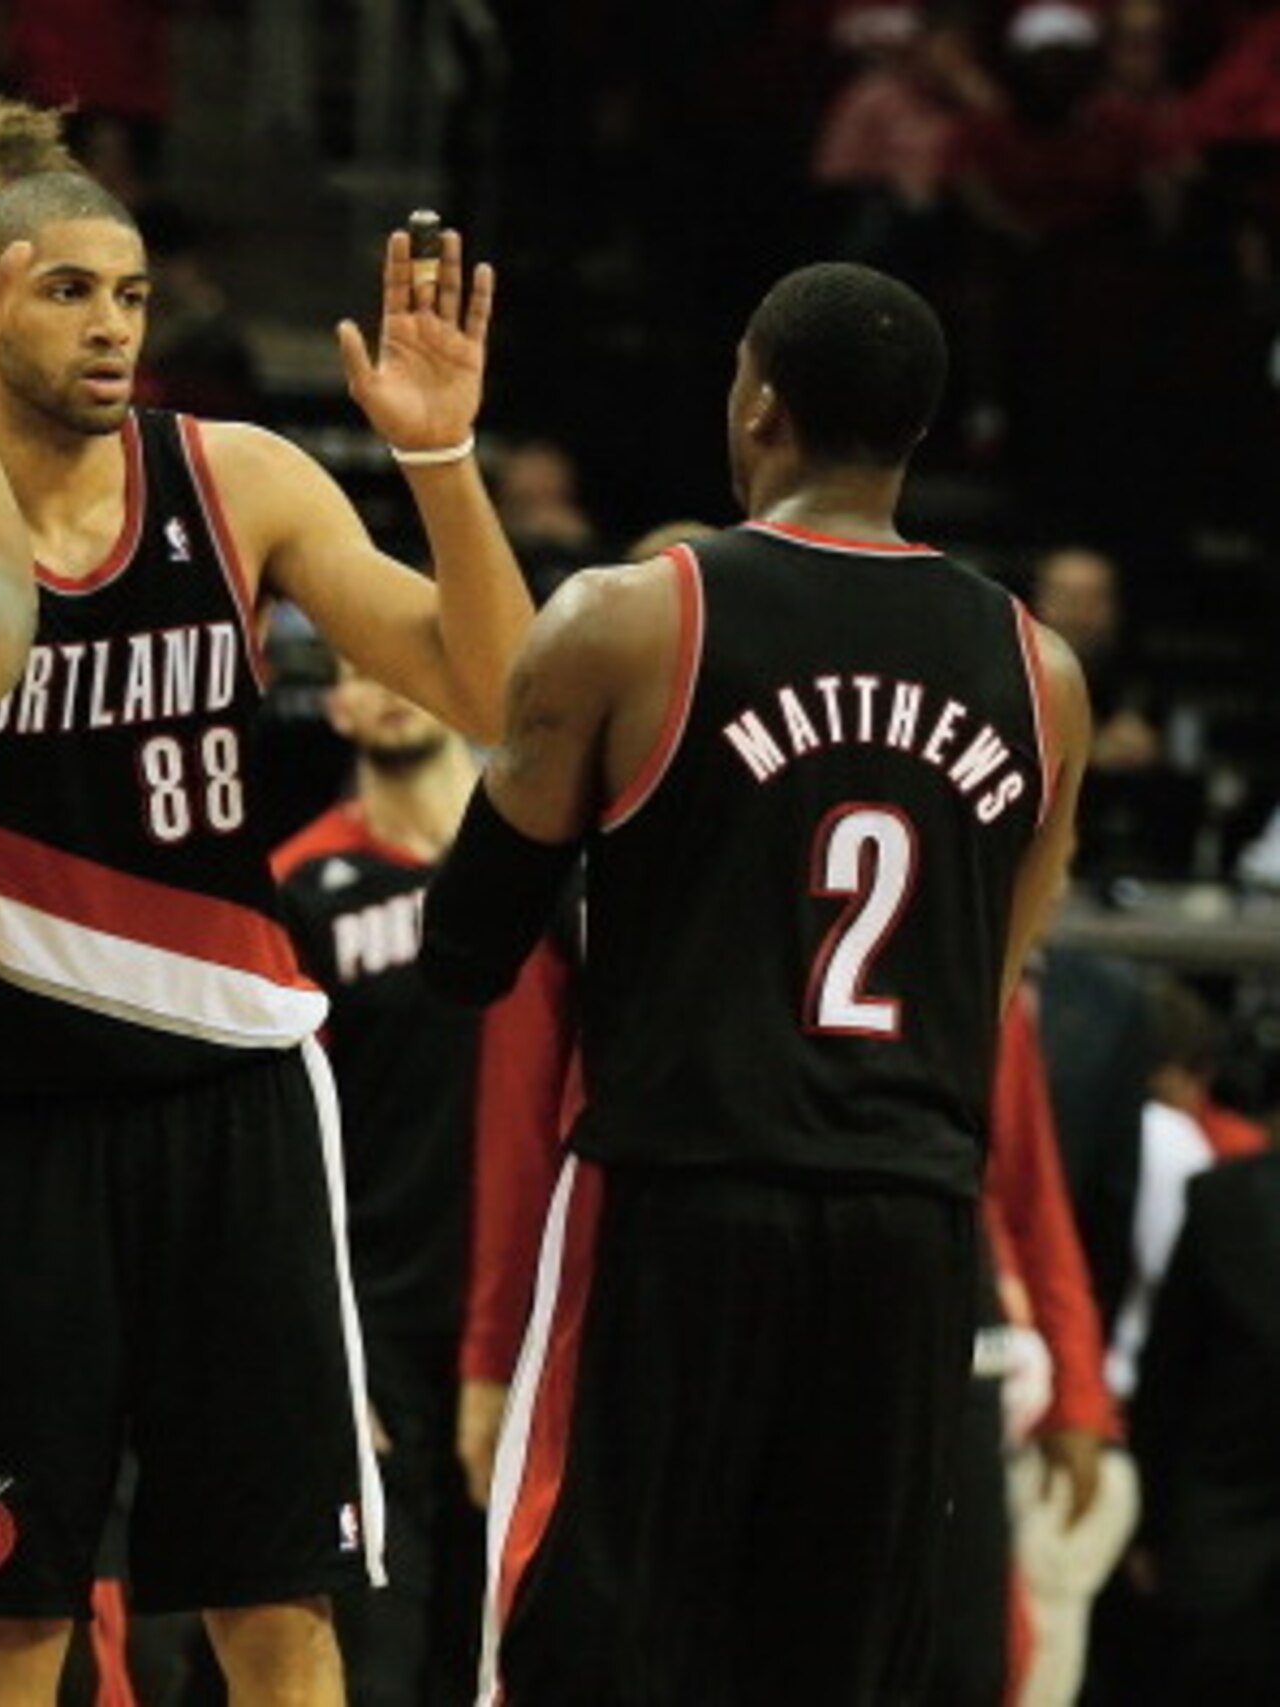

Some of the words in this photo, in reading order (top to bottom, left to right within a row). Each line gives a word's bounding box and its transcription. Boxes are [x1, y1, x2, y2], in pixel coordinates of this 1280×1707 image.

[142, 726, 245, 843] 88
[722, 676, 1025, 825] MATTHEWS
[806, 803, 920, 1037] 2
